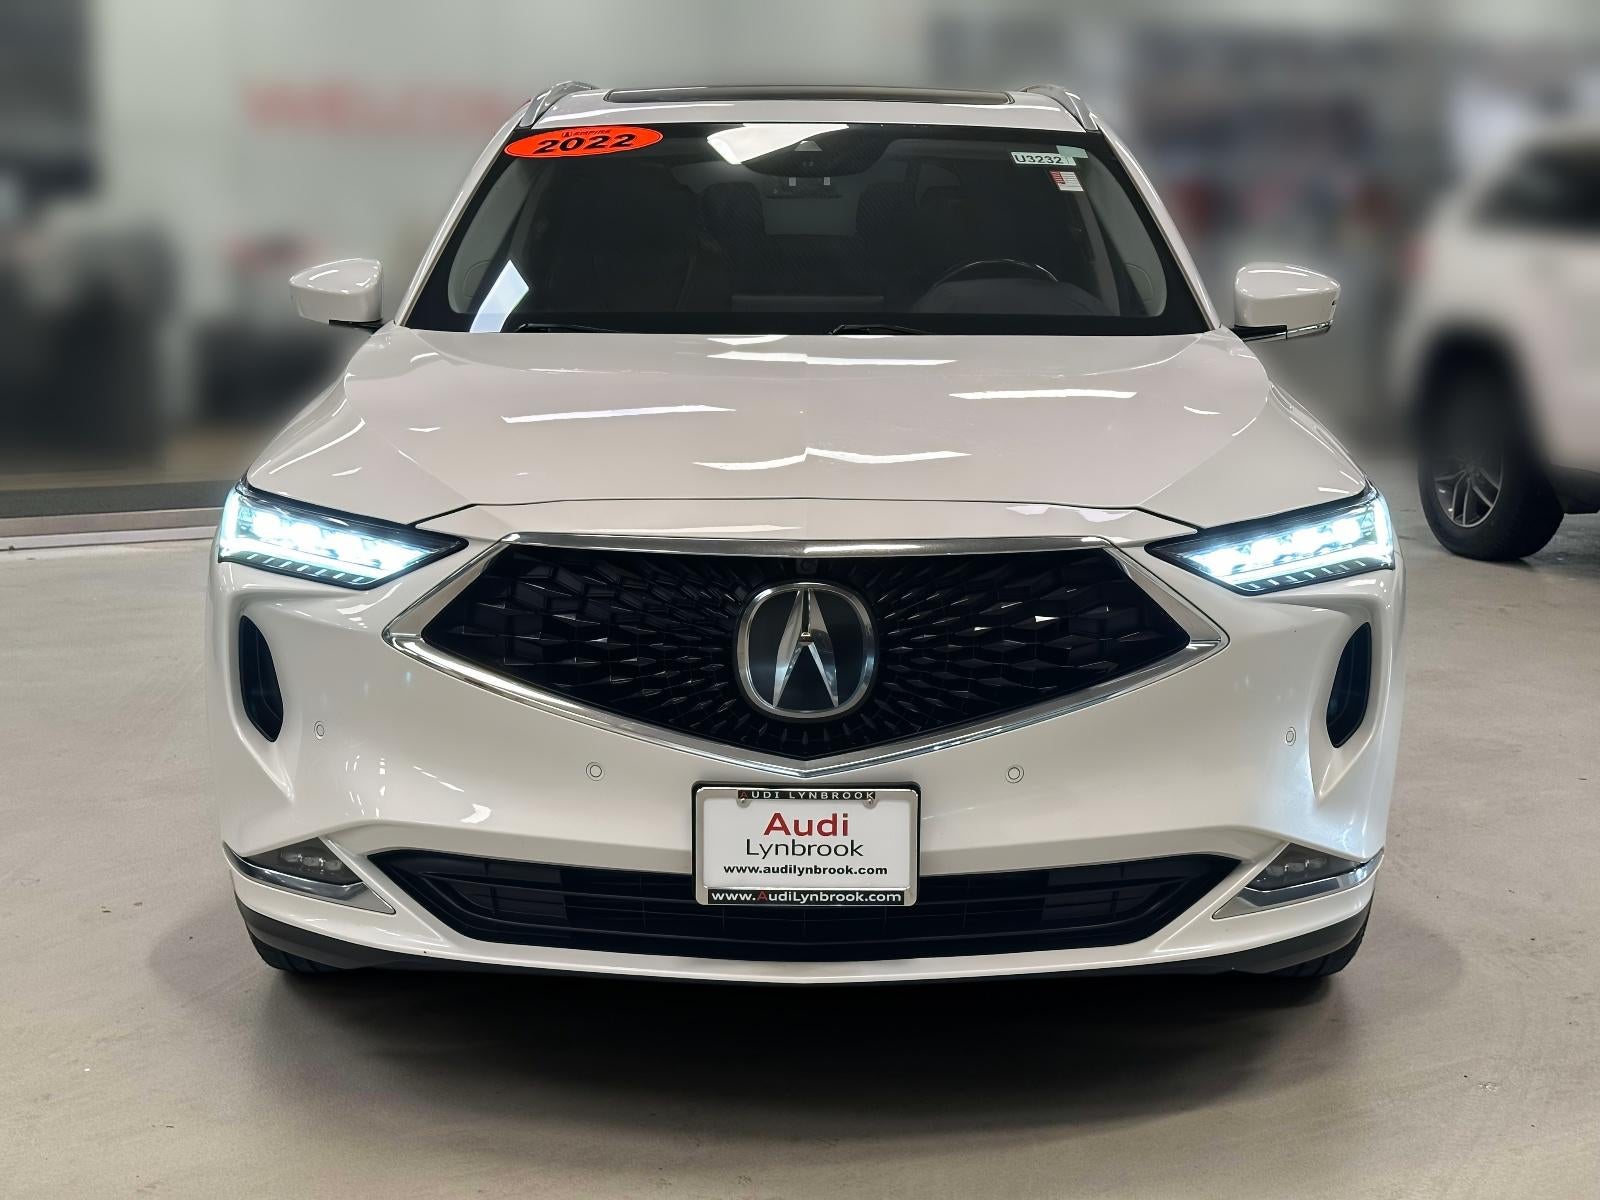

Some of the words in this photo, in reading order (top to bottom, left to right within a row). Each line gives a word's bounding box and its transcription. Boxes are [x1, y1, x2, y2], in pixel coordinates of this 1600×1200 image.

[533, 133, 637, 155] 2022
[1014, 154, 1063, 164] U3232
[740, 791, 780, 800] AUDI
[789, 791, 875, 800] LYNBROOK
[763, 812, 849, 837] Audi
[746, 838, 864, 859] Lynbrook
[723, 865, 888, 876] www.audilynbrook.com
[711, 889, 902, 904] www.AudiLynbrook.com
